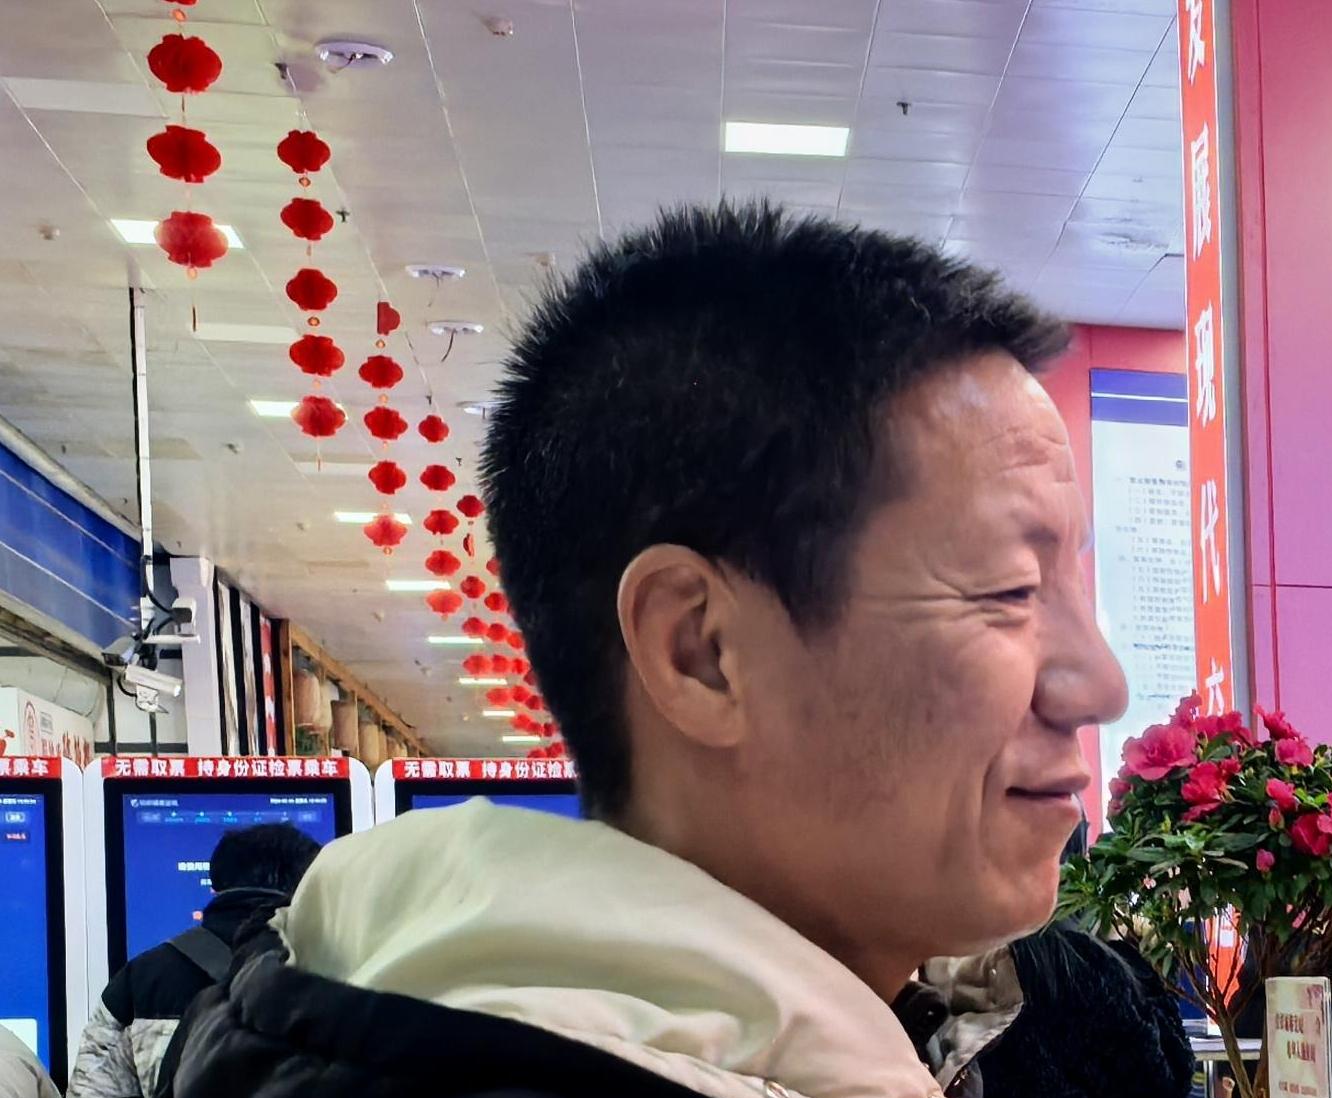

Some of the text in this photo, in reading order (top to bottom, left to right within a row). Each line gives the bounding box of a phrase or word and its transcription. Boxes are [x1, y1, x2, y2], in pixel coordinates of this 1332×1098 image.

[115, 759, 338, 777] 无需取票 持身份证检票乘车
[404, 760, 471, 778] 无需取票
